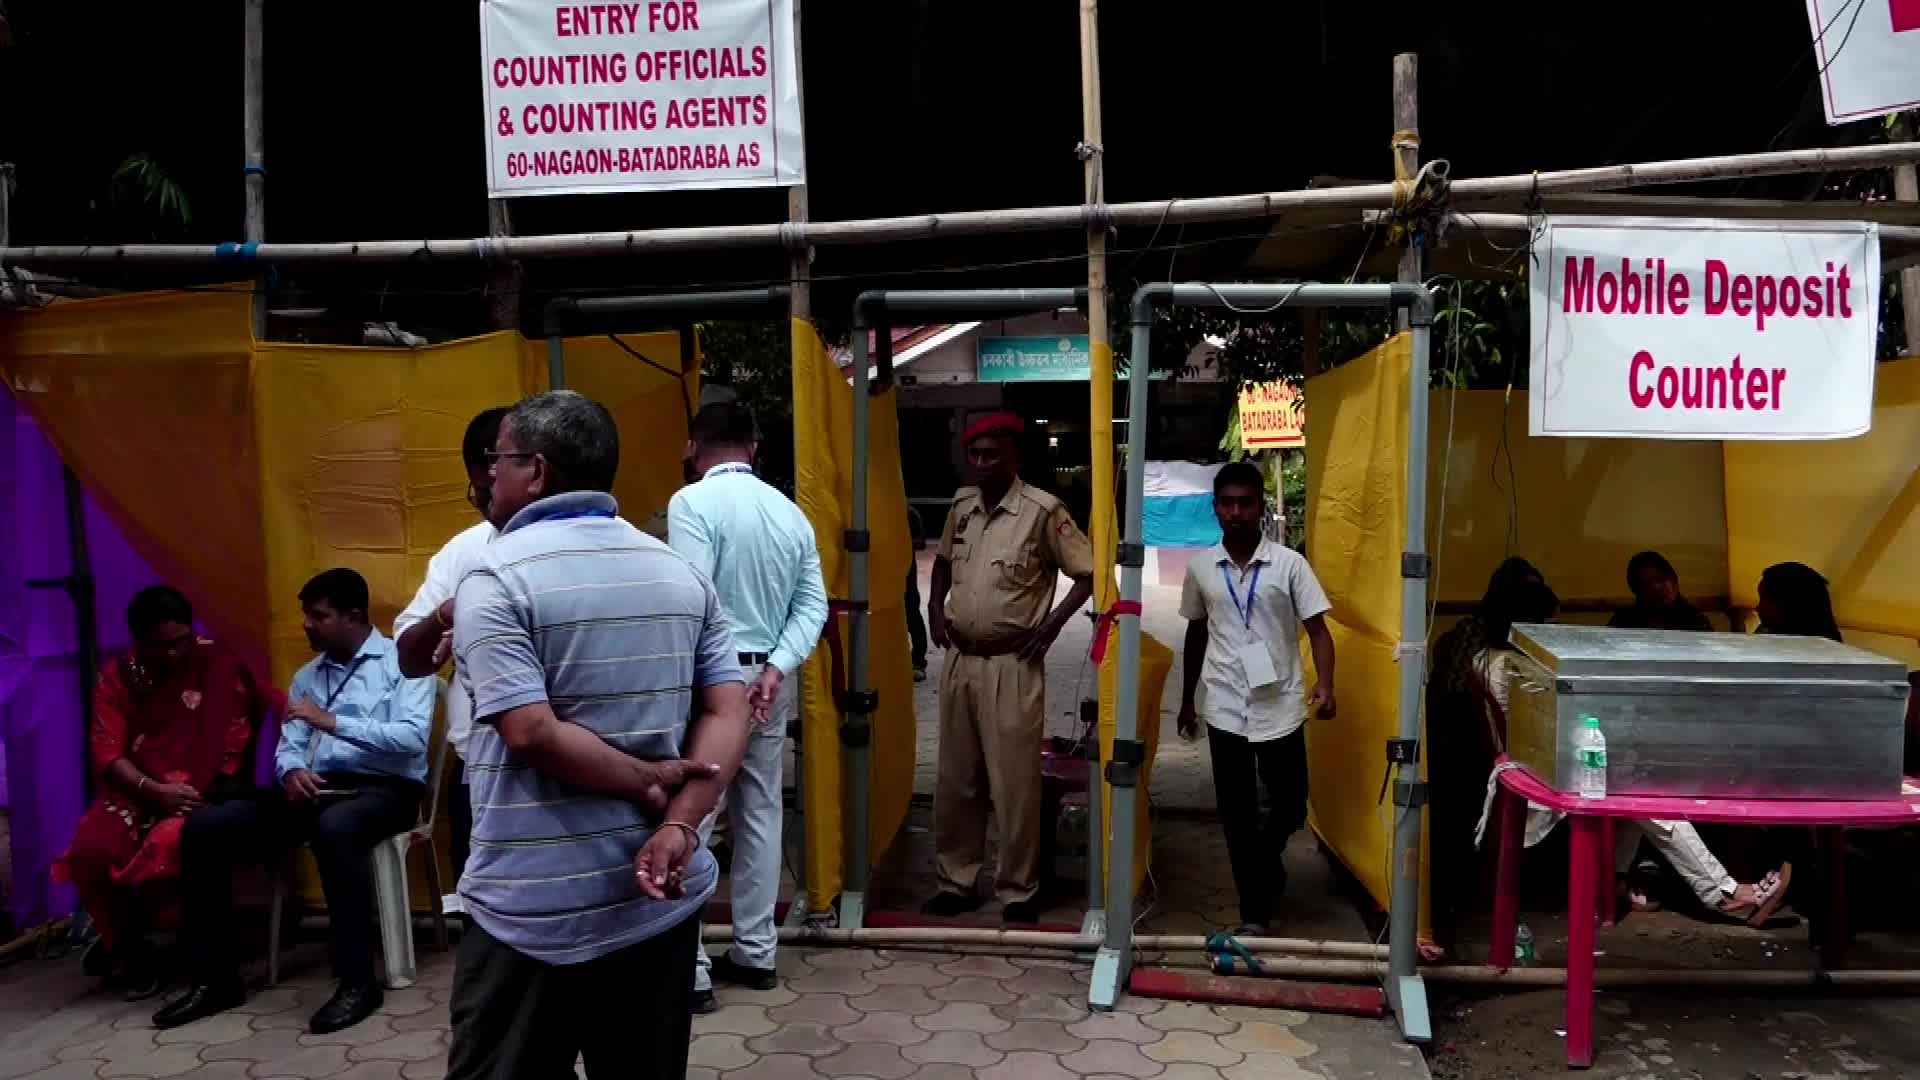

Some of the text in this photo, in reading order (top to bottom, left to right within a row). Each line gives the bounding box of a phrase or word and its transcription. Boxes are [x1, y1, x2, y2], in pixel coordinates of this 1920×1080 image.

[556, 0, 700, 37] ENTRY FOR
[493, 45, 768, 89] COUNTING OFFICIALS
[497, 94, 768, 137] & COUNTING AGENTS
[506, 142, 761, 178] 60-NAGAON-BATADRABA AS
[1562, 255, 1854, 333] Mobile Deposit
[1628, 350, 1788, 411] Counter
